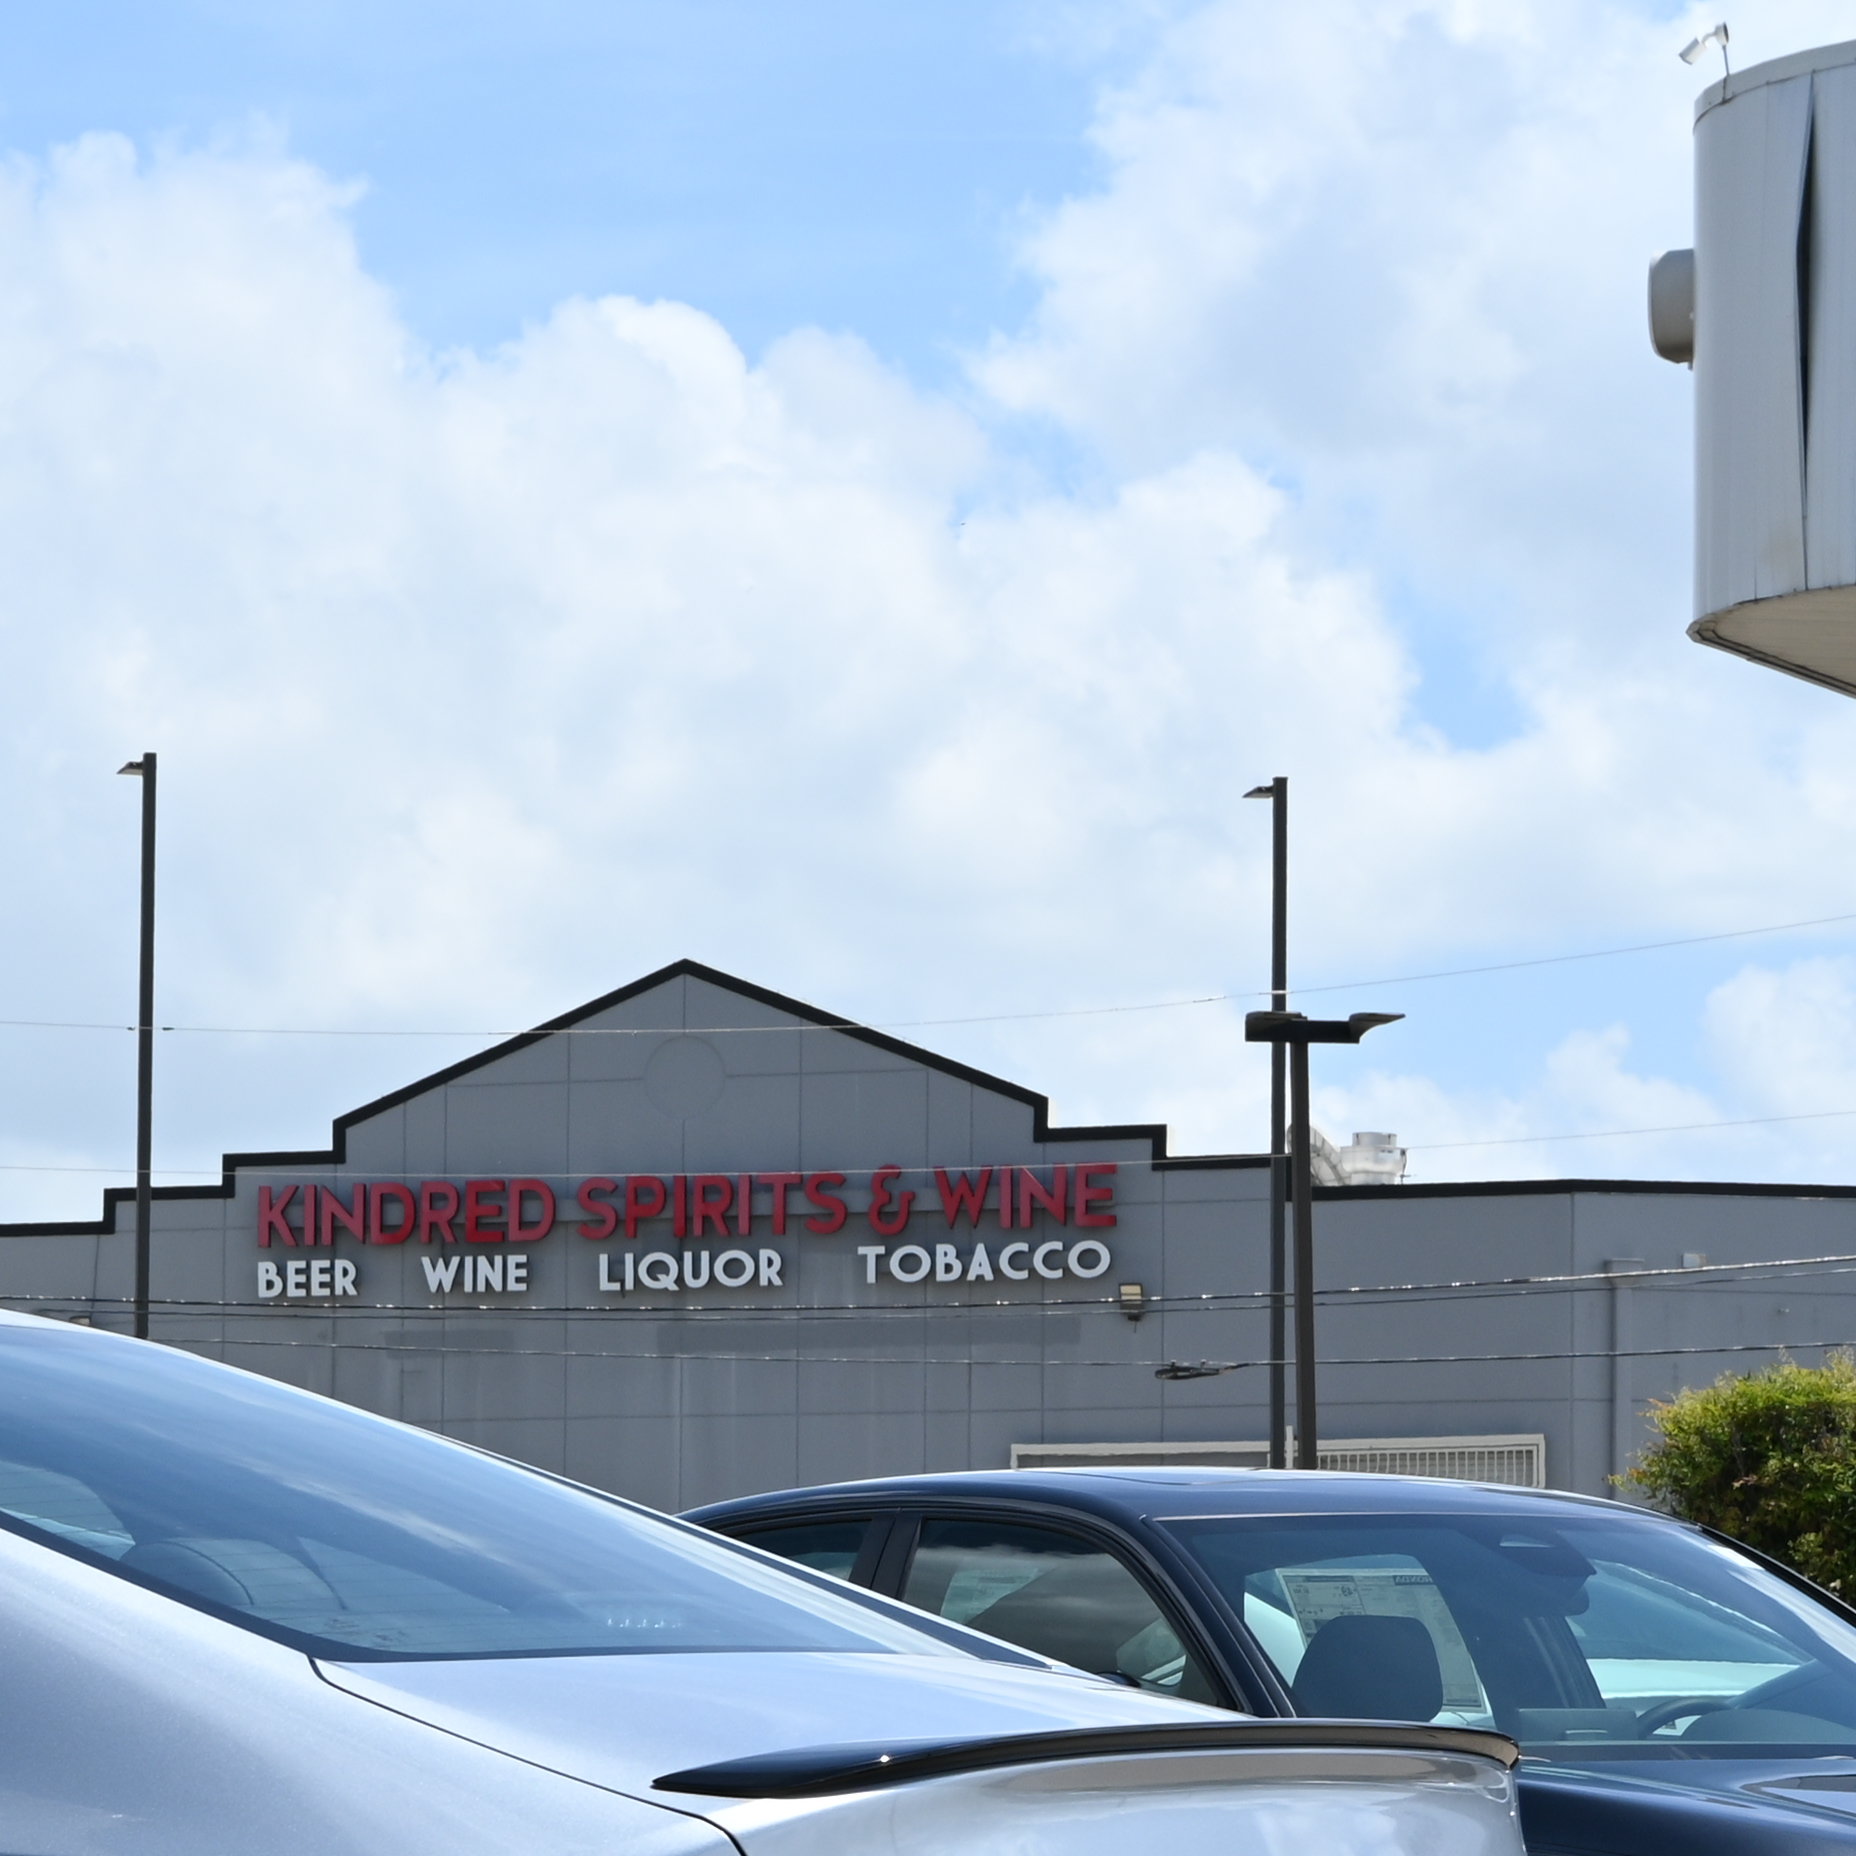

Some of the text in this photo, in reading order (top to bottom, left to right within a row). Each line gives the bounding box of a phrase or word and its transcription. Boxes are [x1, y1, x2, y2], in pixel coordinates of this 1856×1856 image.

[257, 1162, 1118, 1248] KINDRED SPIRITS & WINE
[257, 1240, 1112, 1299] BEER WINE LIQUOR TOBACCO
